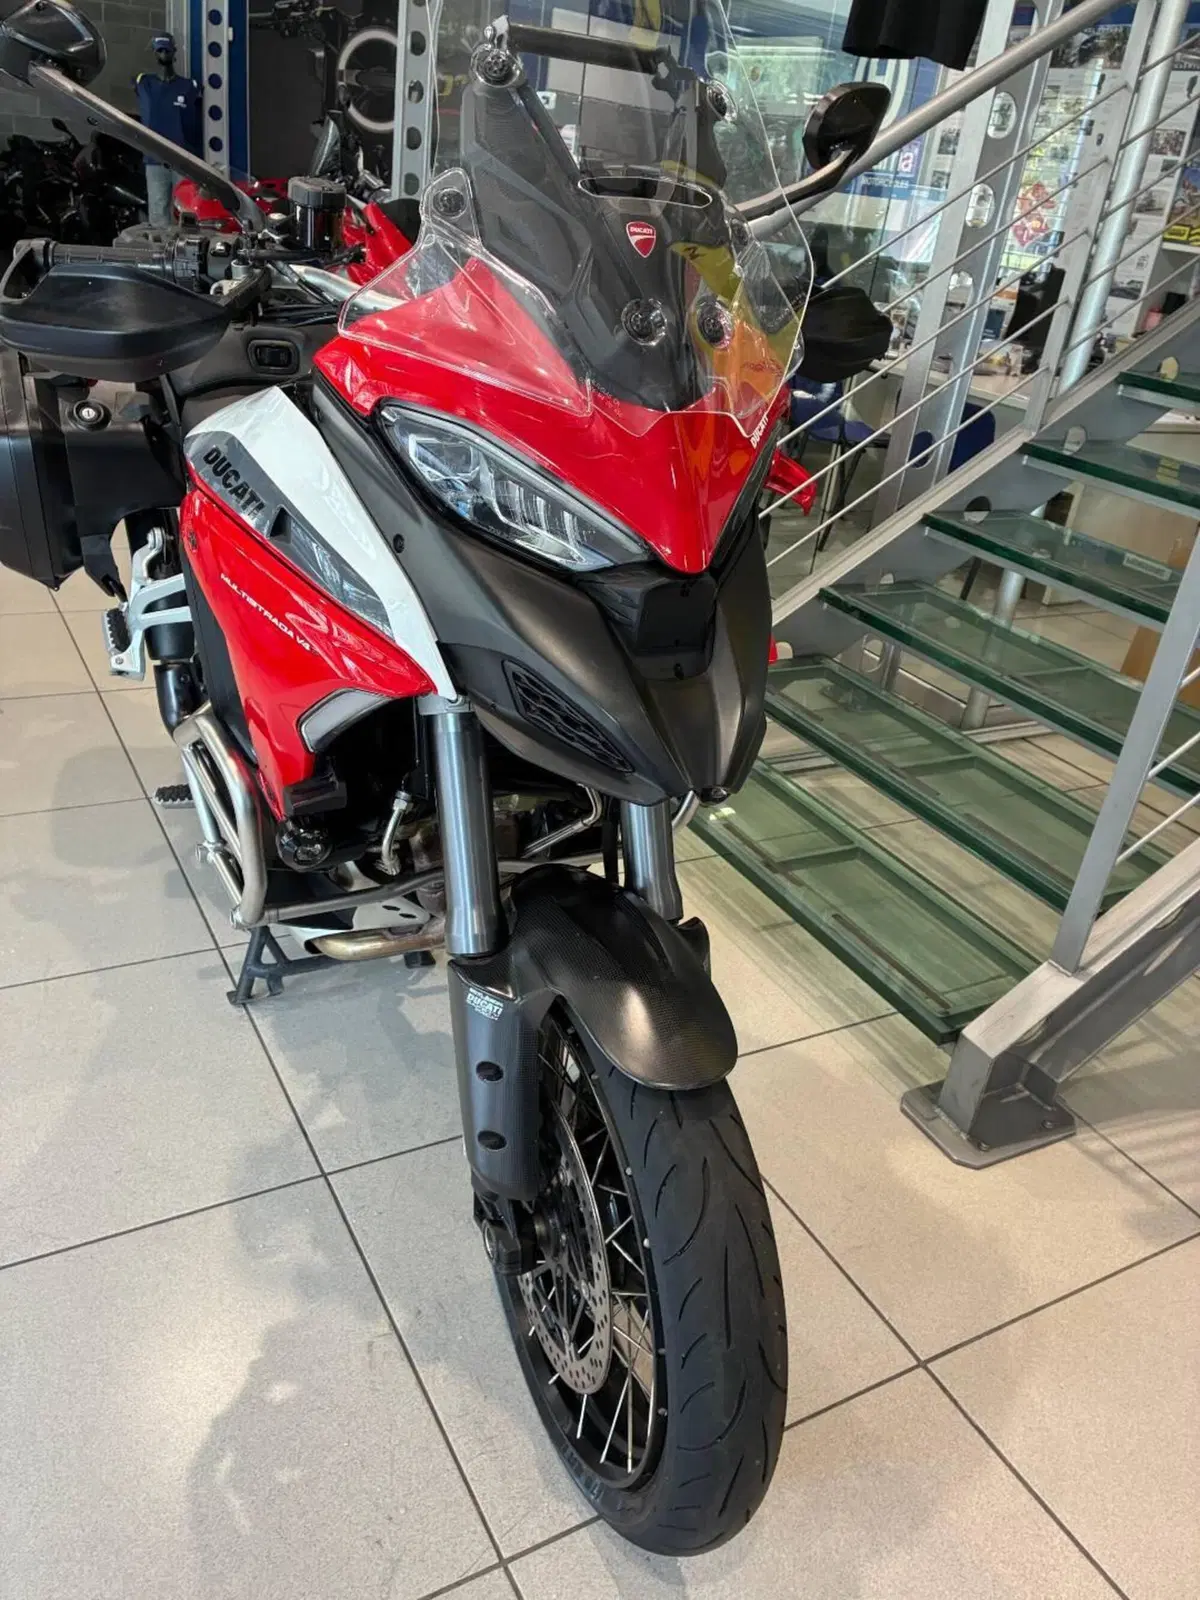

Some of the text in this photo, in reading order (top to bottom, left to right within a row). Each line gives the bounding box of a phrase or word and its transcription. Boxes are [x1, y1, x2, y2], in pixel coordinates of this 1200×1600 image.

[630, 226, 653, 235] DUCATI
[750, 415, 769, 450] DUCATI
[202, 447, 266, 518] DUCATI
[220, 573, 311, 652] MULTISTRADA V4
[467, 992, 503, 1016] DUCATI
